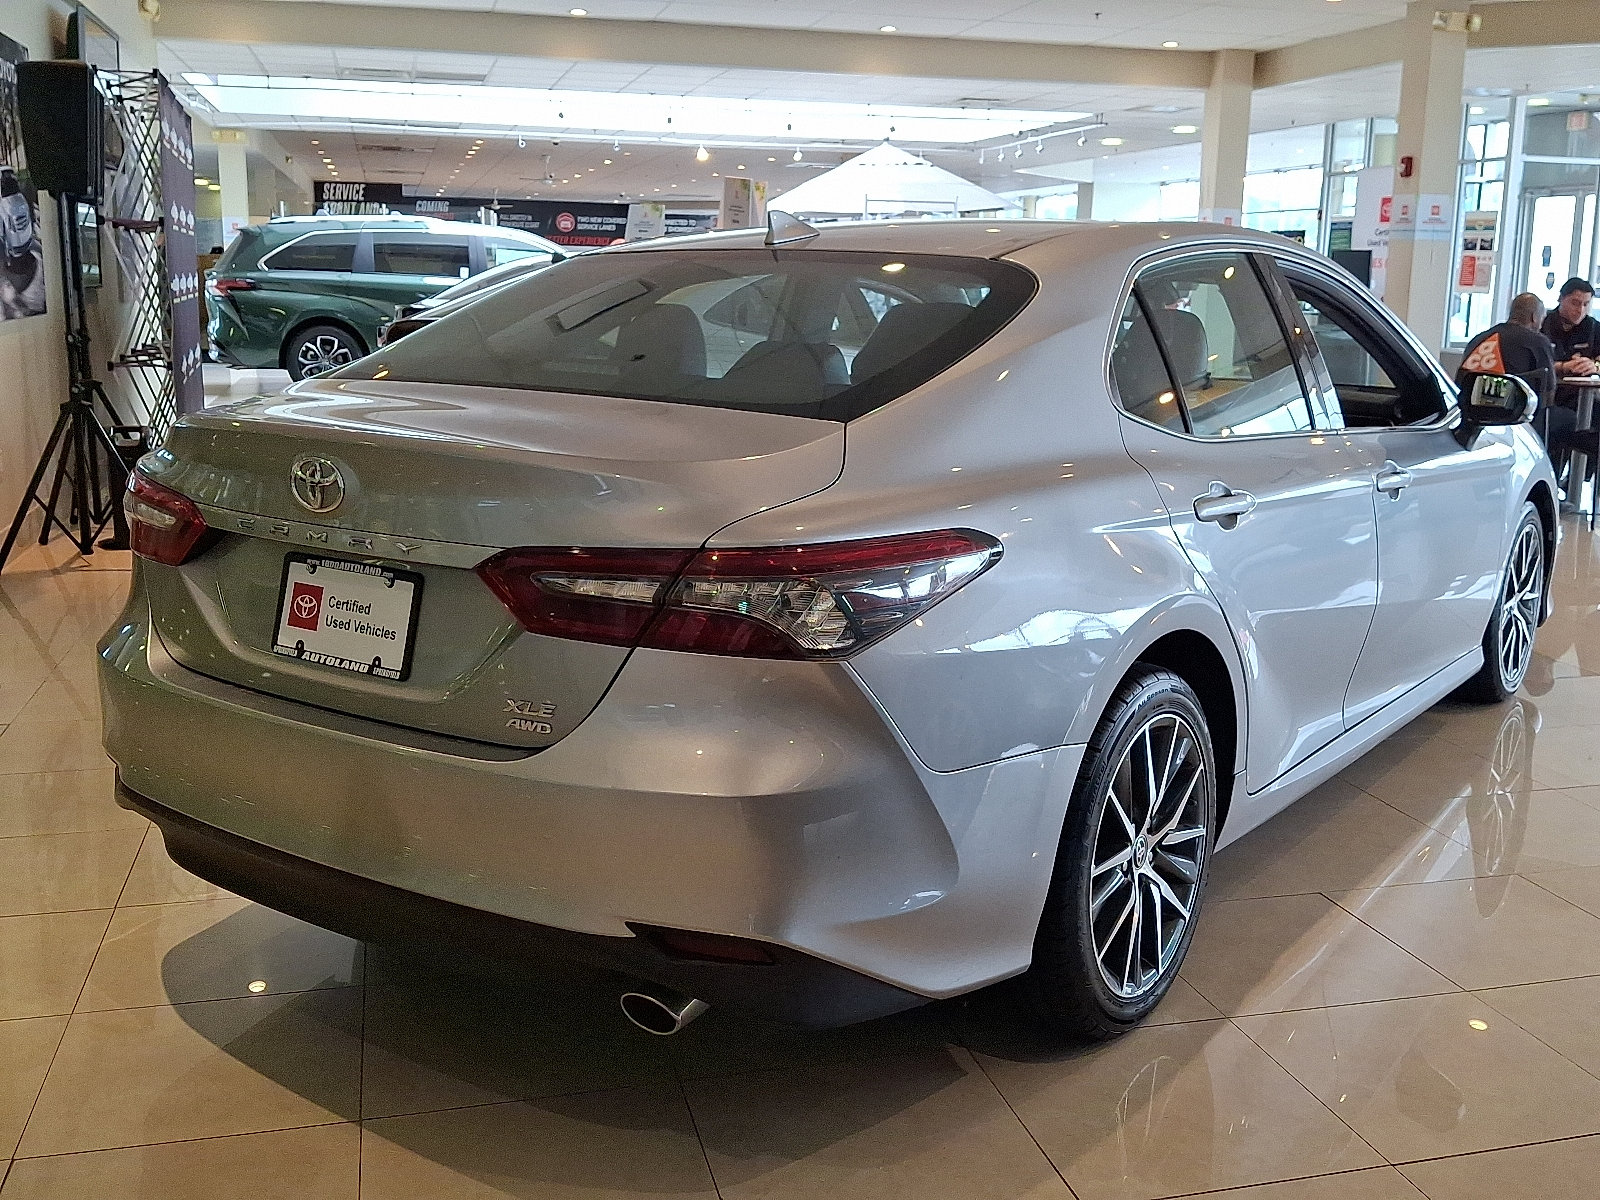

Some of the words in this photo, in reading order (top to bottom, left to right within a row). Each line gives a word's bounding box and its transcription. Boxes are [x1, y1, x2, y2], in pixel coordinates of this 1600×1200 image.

[323, 183, 366, 201] SERVICE
[416, 201, 449, 213] COMING
[237, 518, 422, 555] CAMRY
[328, 595, 371, 615] Certified
[326, 614, 351, 631] Used
[354, 620, 397, 641] Vehicles
[301, 651, 369, 673] AUTOLAND
[502, 699, 557, 718] XLE
[505, 718, 553, 734] AWD
